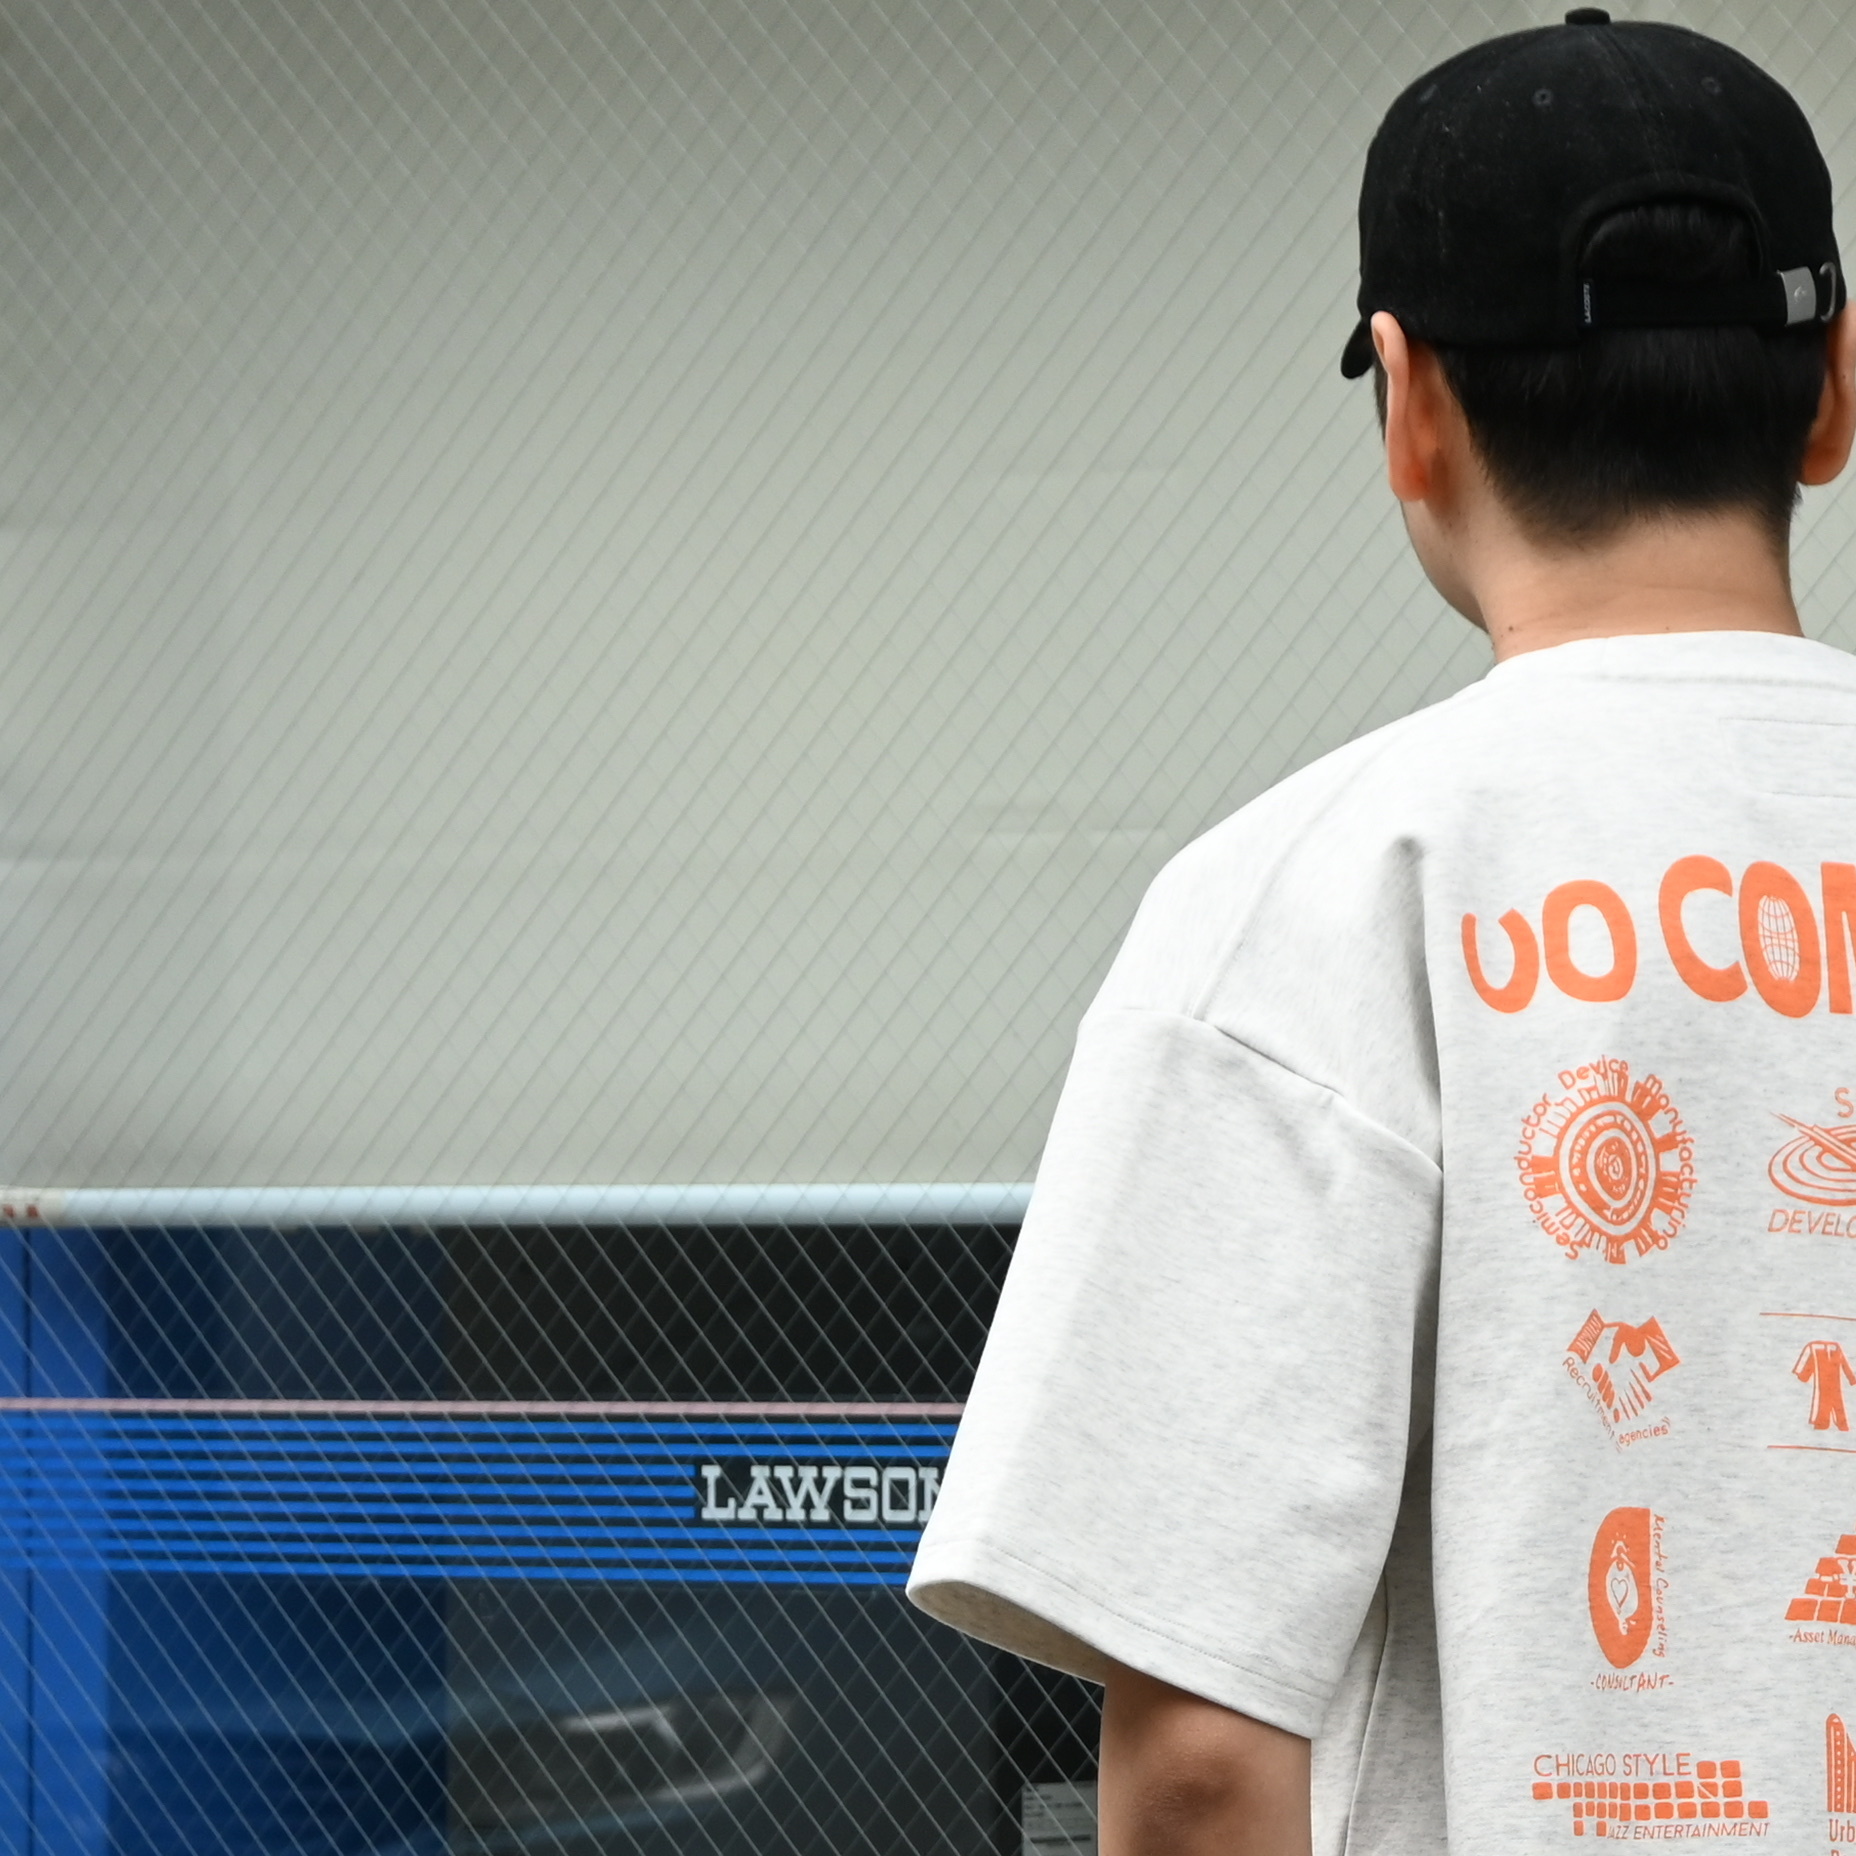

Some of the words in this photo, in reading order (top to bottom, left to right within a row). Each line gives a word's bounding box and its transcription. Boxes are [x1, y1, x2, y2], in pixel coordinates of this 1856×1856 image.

[1556, 1054, 1630, 1091] Device
[1530, 1750, 1618, 1777] CHICAGO
[1620, 1750, 1692, 1777] STYLE
[1631, 1820, 1772, 1842] ENTERTAINMENT
